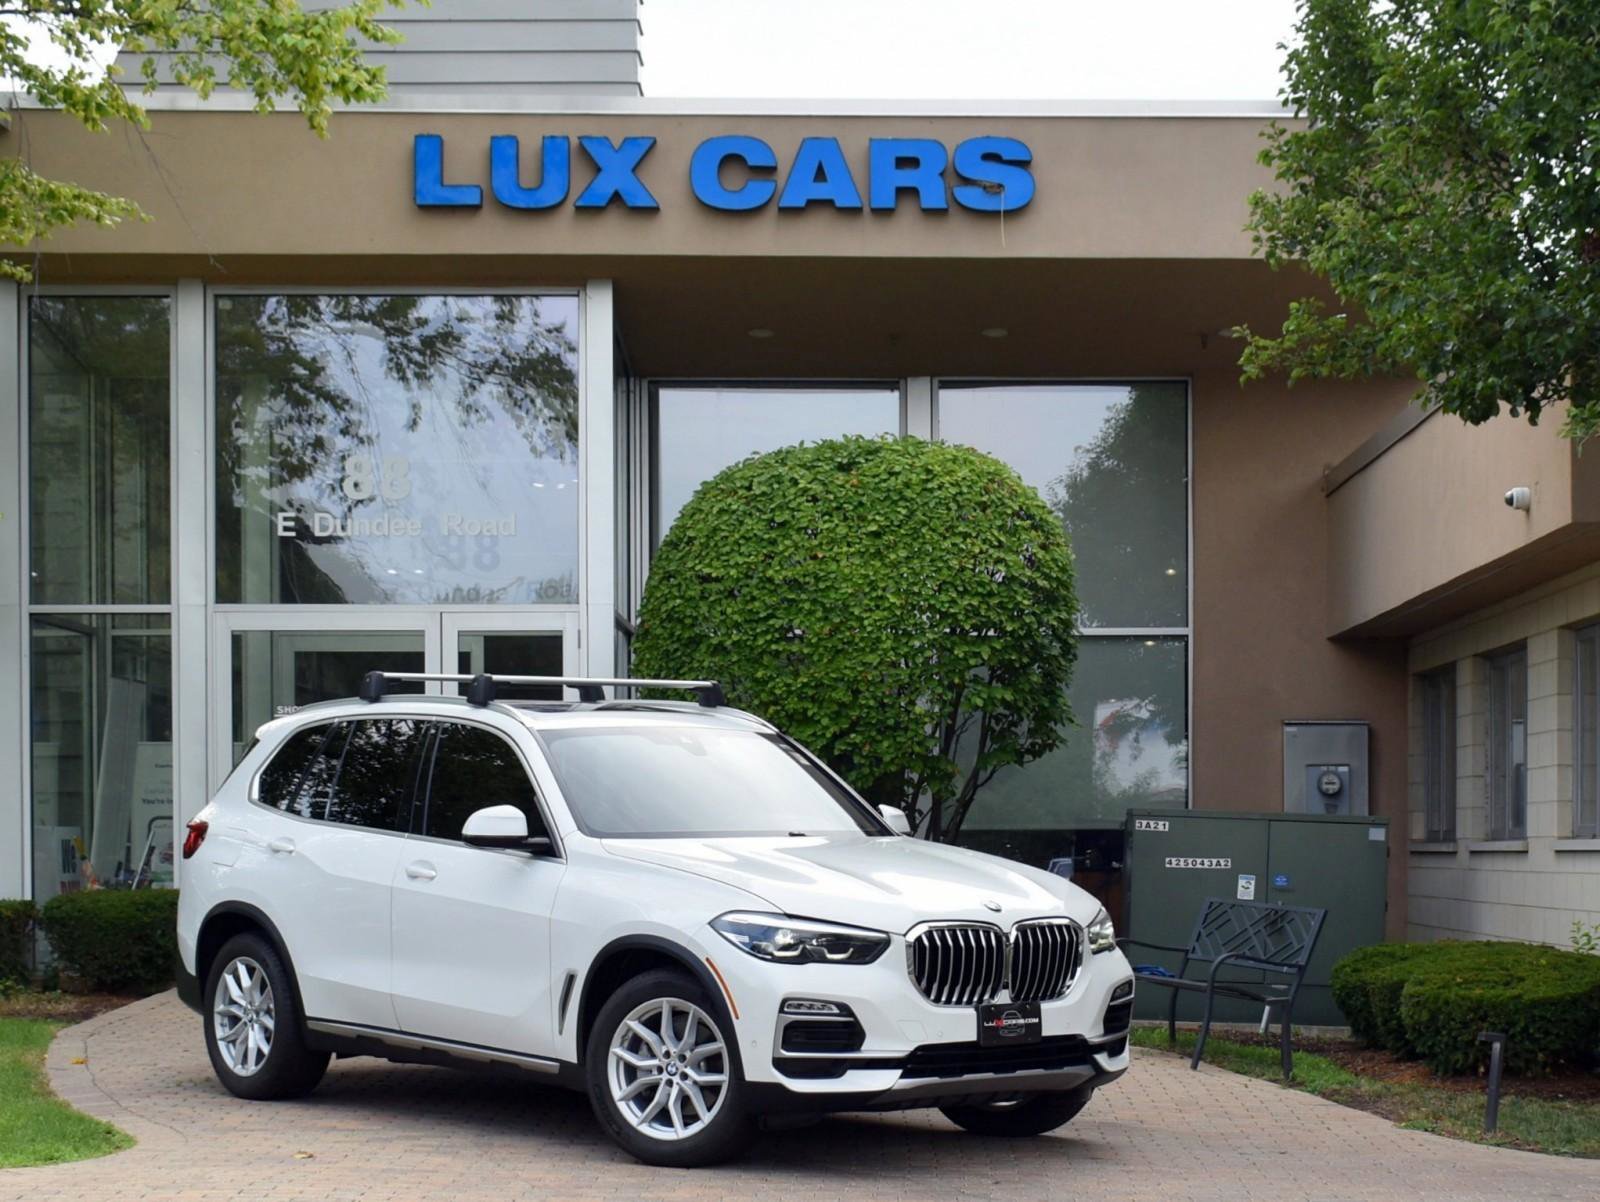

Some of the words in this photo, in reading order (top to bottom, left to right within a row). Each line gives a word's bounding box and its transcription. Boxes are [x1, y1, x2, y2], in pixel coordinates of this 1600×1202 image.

[414, 134, 660, 211] LUX
[689, 136, 1036, 214] CARS
[343, 454, 411, 500] 88
[276, 512, 297, 538] E
[313, 512, 423, 538] Dundee
[442, 512, 518, 537] Road
[1136, 820, 1168, 831] 3A21
[1165, 857, 1231, 868] 425043A2
